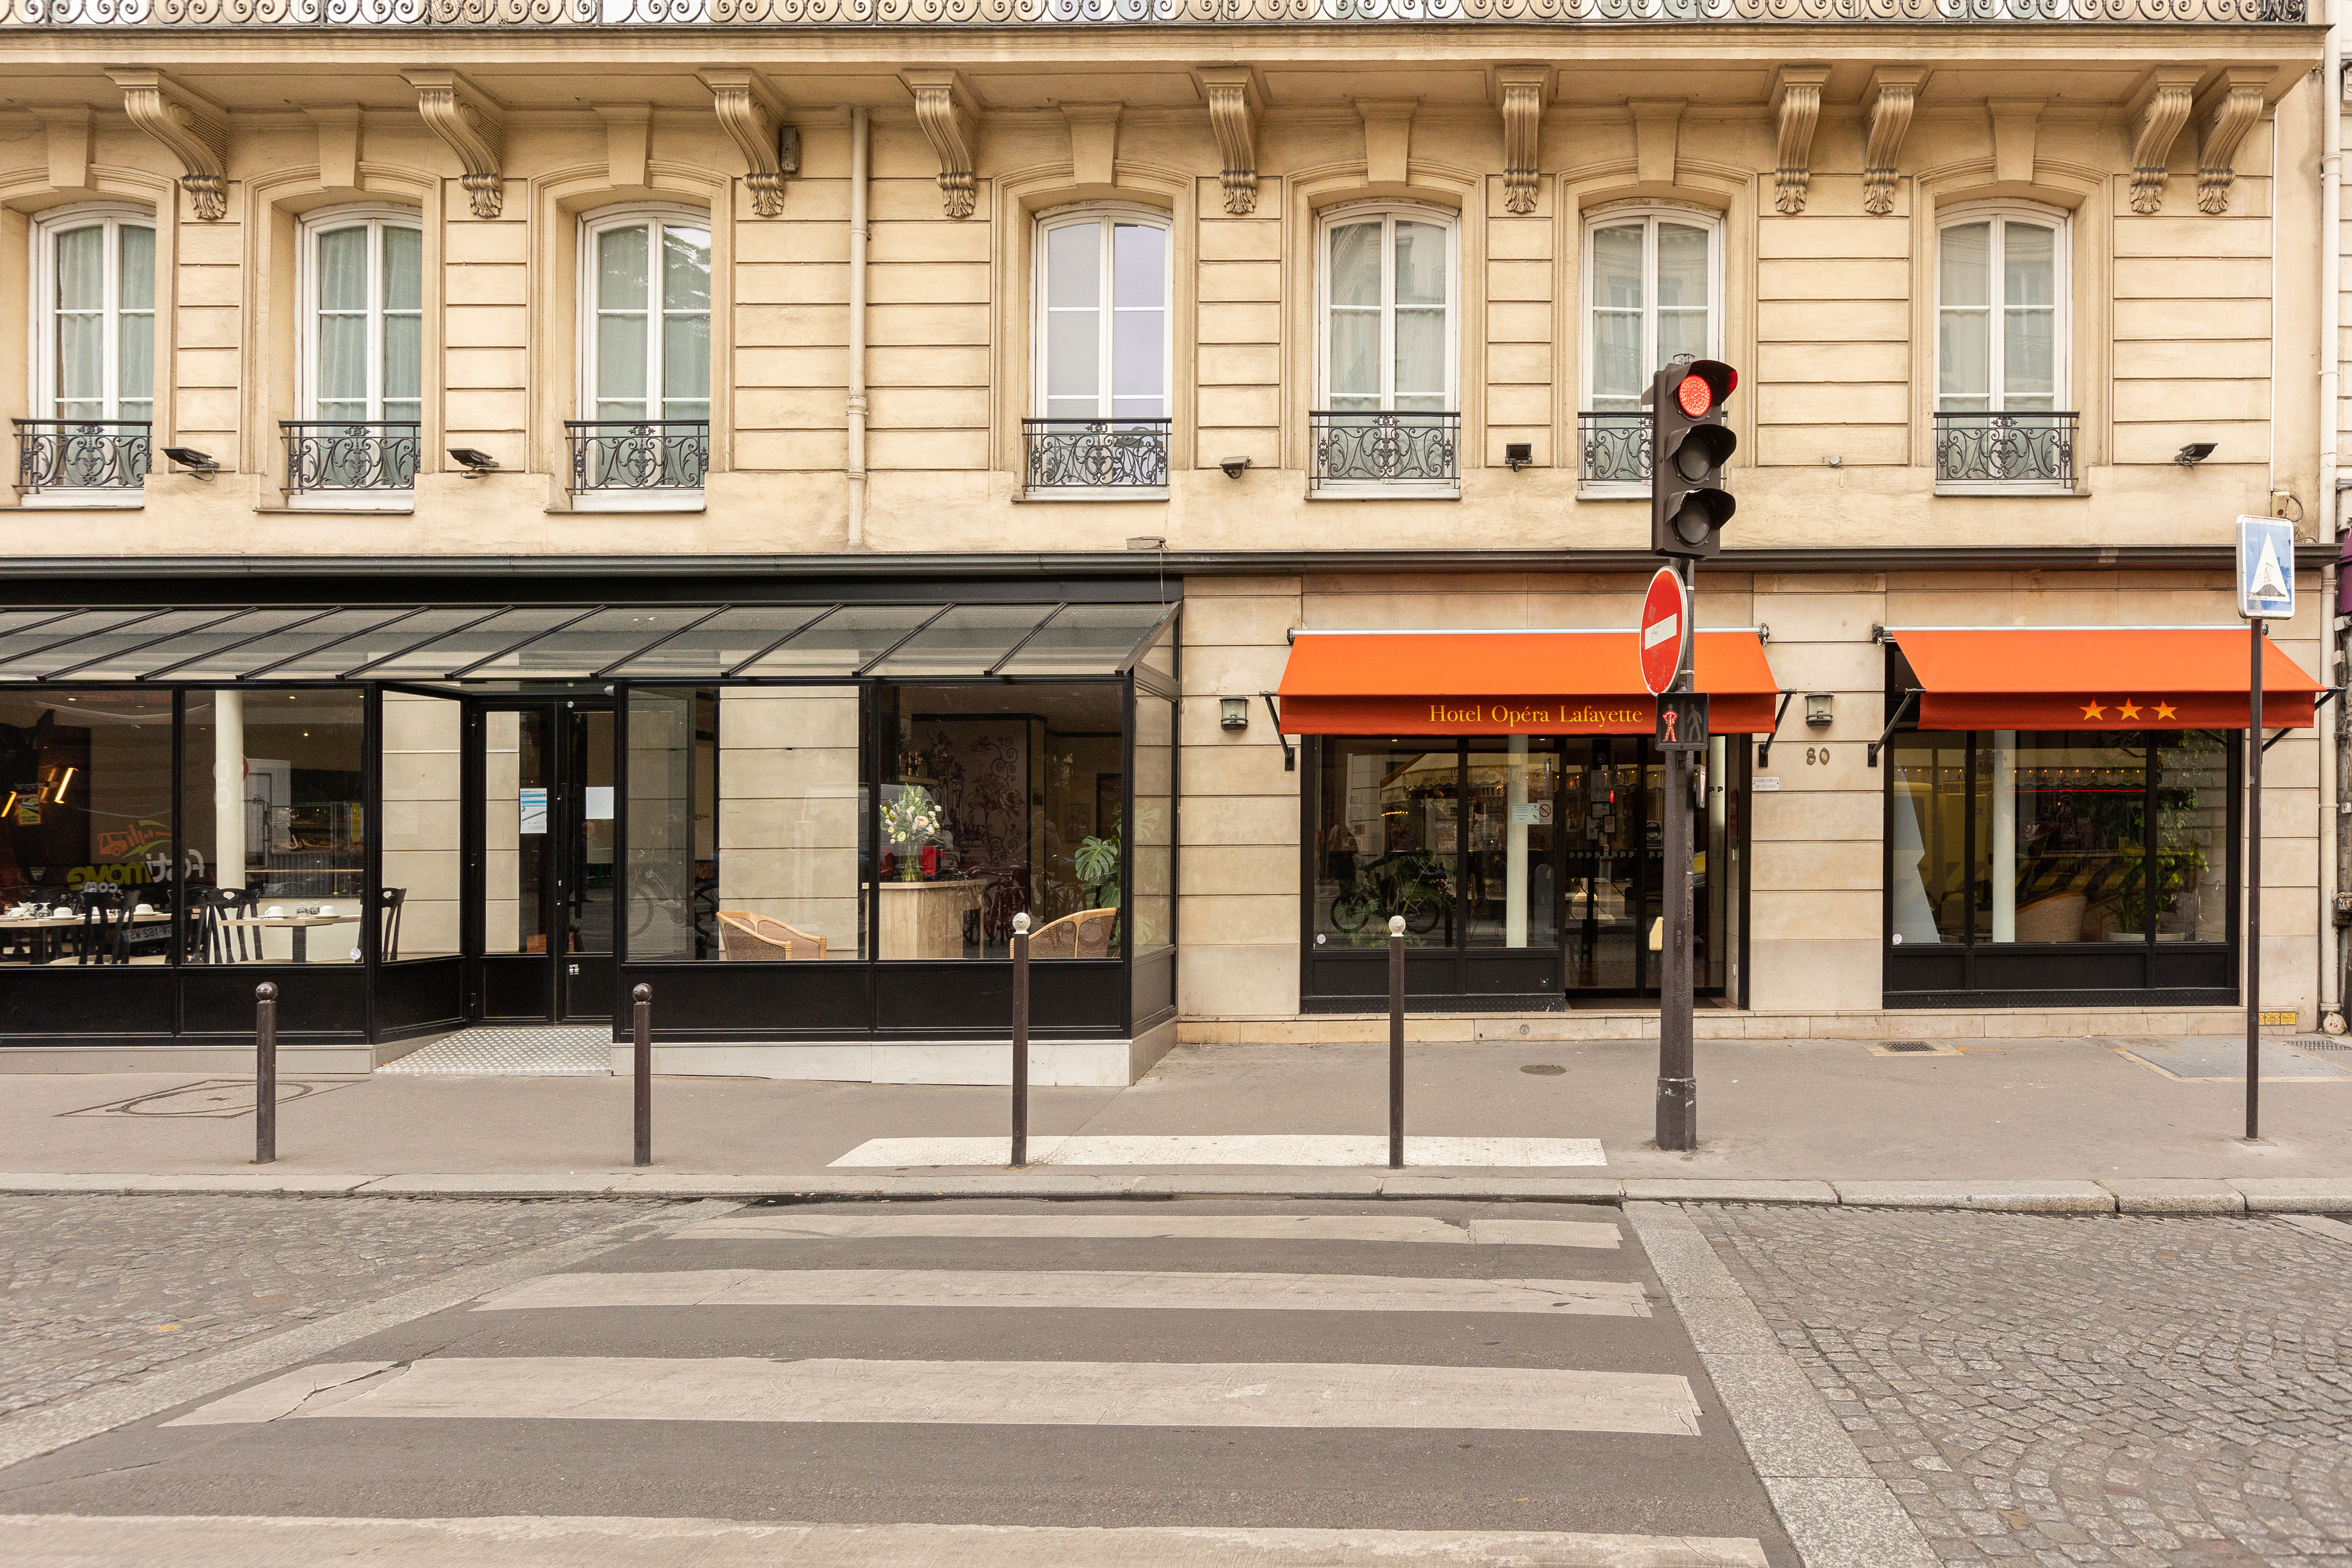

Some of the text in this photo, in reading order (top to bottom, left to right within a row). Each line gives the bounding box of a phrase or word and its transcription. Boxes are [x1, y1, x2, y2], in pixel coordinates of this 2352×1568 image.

[1429, 705, 1642, 727] Hotel Opéra Lafayette
[1807, 747, 1830, 765] 80
